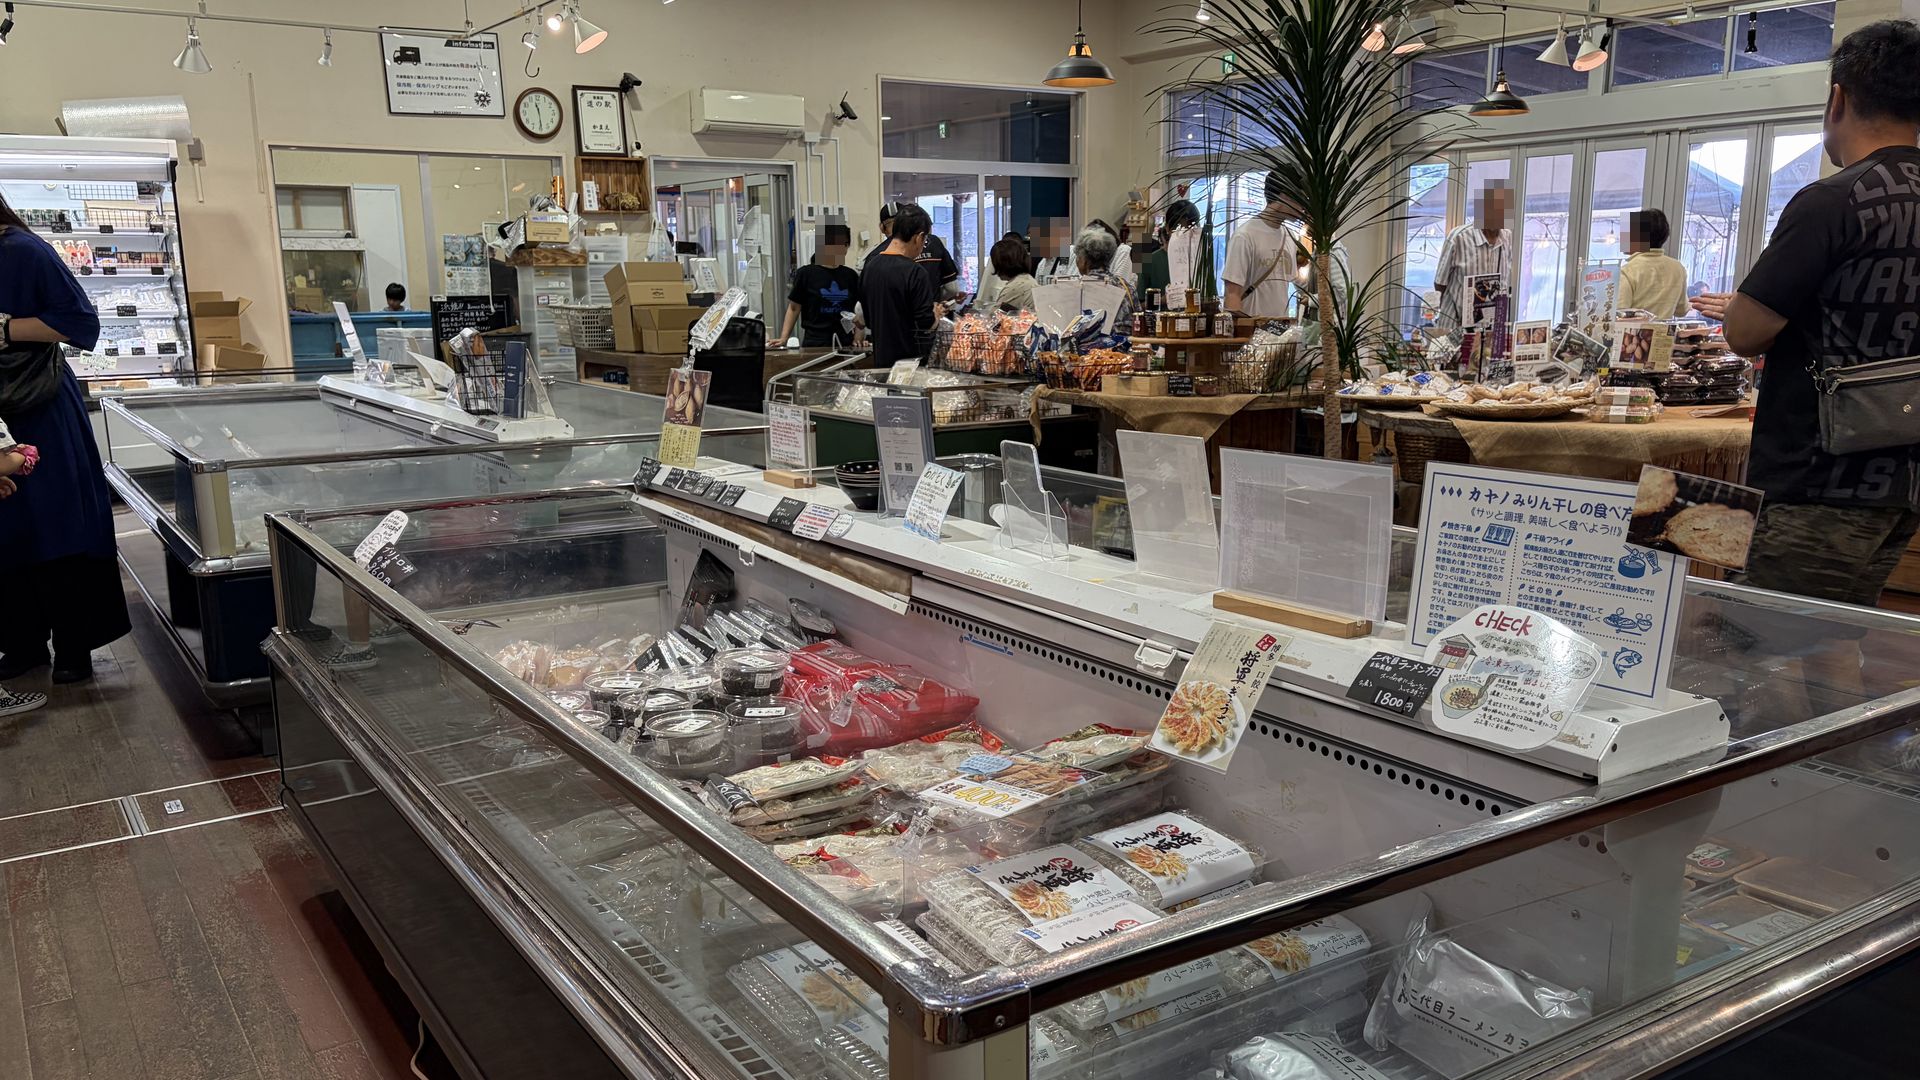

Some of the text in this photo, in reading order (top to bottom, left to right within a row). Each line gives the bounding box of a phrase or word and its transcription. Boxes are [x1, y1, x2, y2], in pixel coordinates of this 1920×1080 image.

[1532, 533, 1566, 546] 干魚フライ
[1528, 585, 1553, 596] その他
[1247, 643, 1282, 699] 博多一口餃子
[1371, 653, 1442, 678] 二代目ラーメンカヨ
[1374, 689, 1414, 713] 1800円
[1163, 957, 1212, 983] 豚骨スープで
[1174, 989, 1223, 1016] 豚骨スープで
